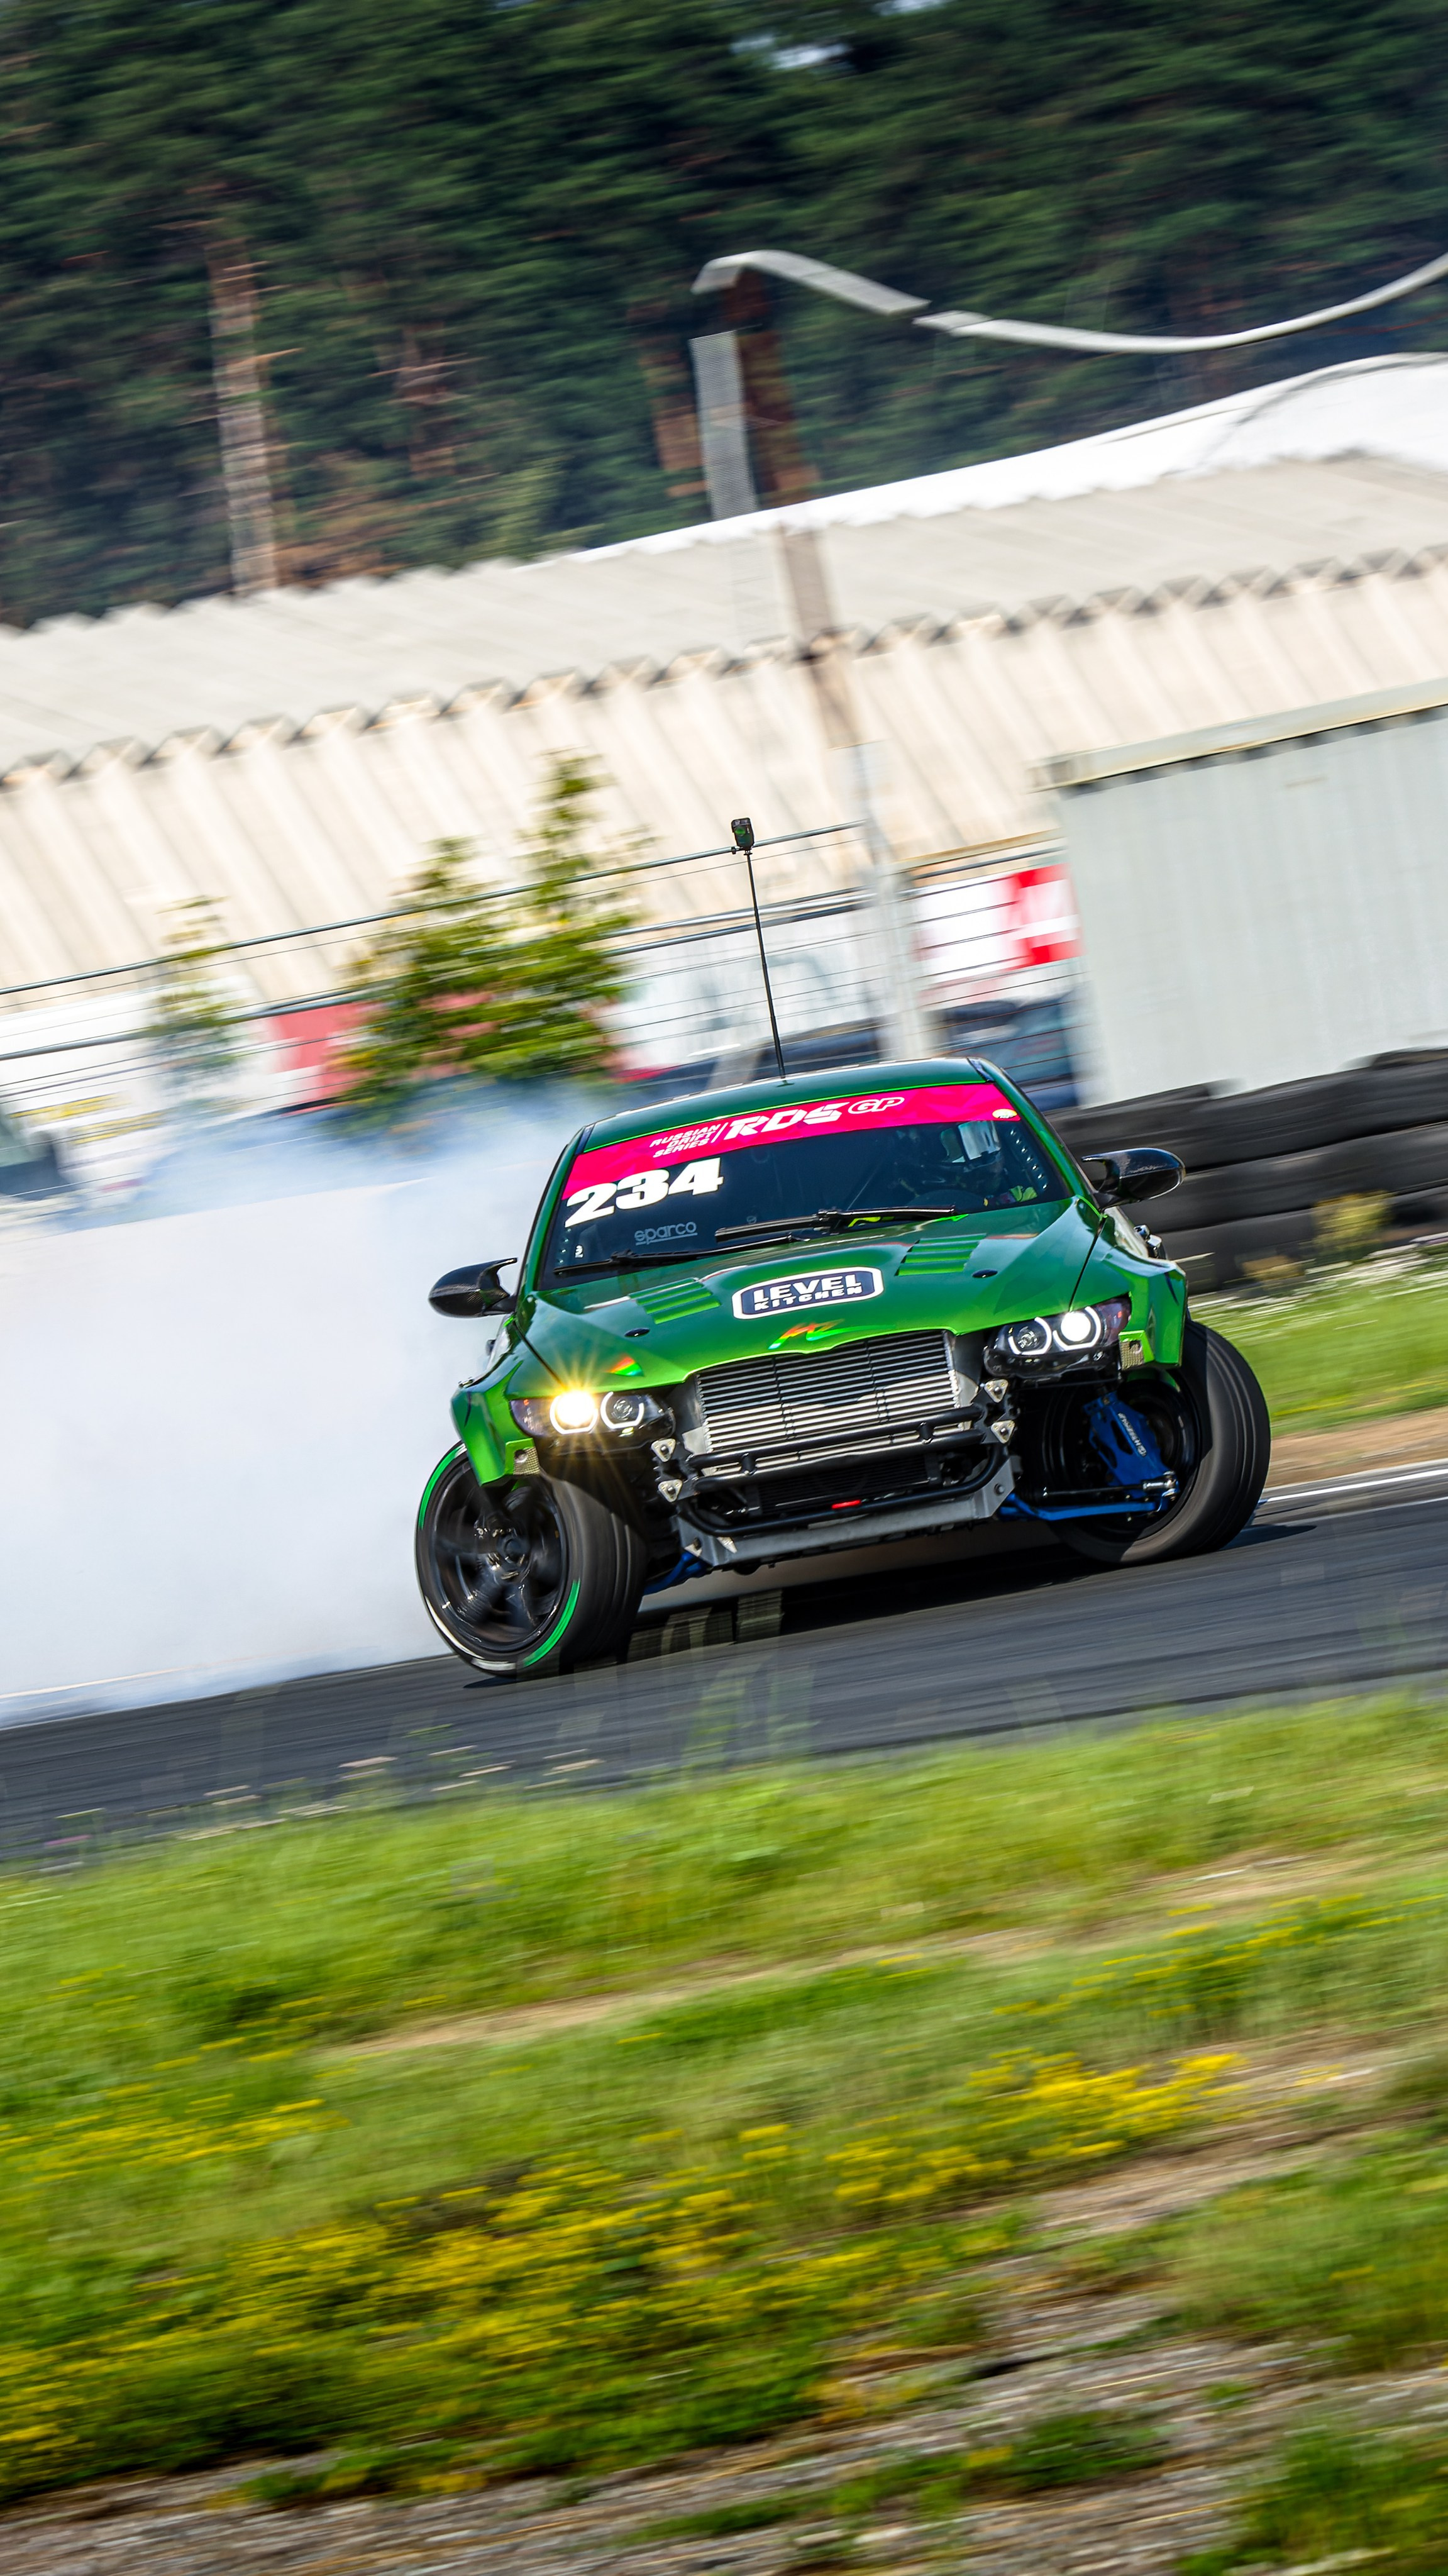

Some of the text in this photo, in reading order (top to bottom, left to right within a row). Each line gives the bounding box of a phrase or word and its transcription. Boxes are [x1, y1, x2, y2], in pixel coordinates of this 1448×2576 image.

[724, 1096, 905, 1140] RDS GP
[649, 1124, 719, 1148] RUSSIAN
[653, 1138, 709, 1158] SERIES
[666, 1131, 716, 1148] DRIFT
[565, 1157, 724, 1228] 234
[634, 1221, 697, 1245] sparco
[753, 1274, 861, 1304] LEVEL
[754, 1286, 863, 1311] KITCHEN
